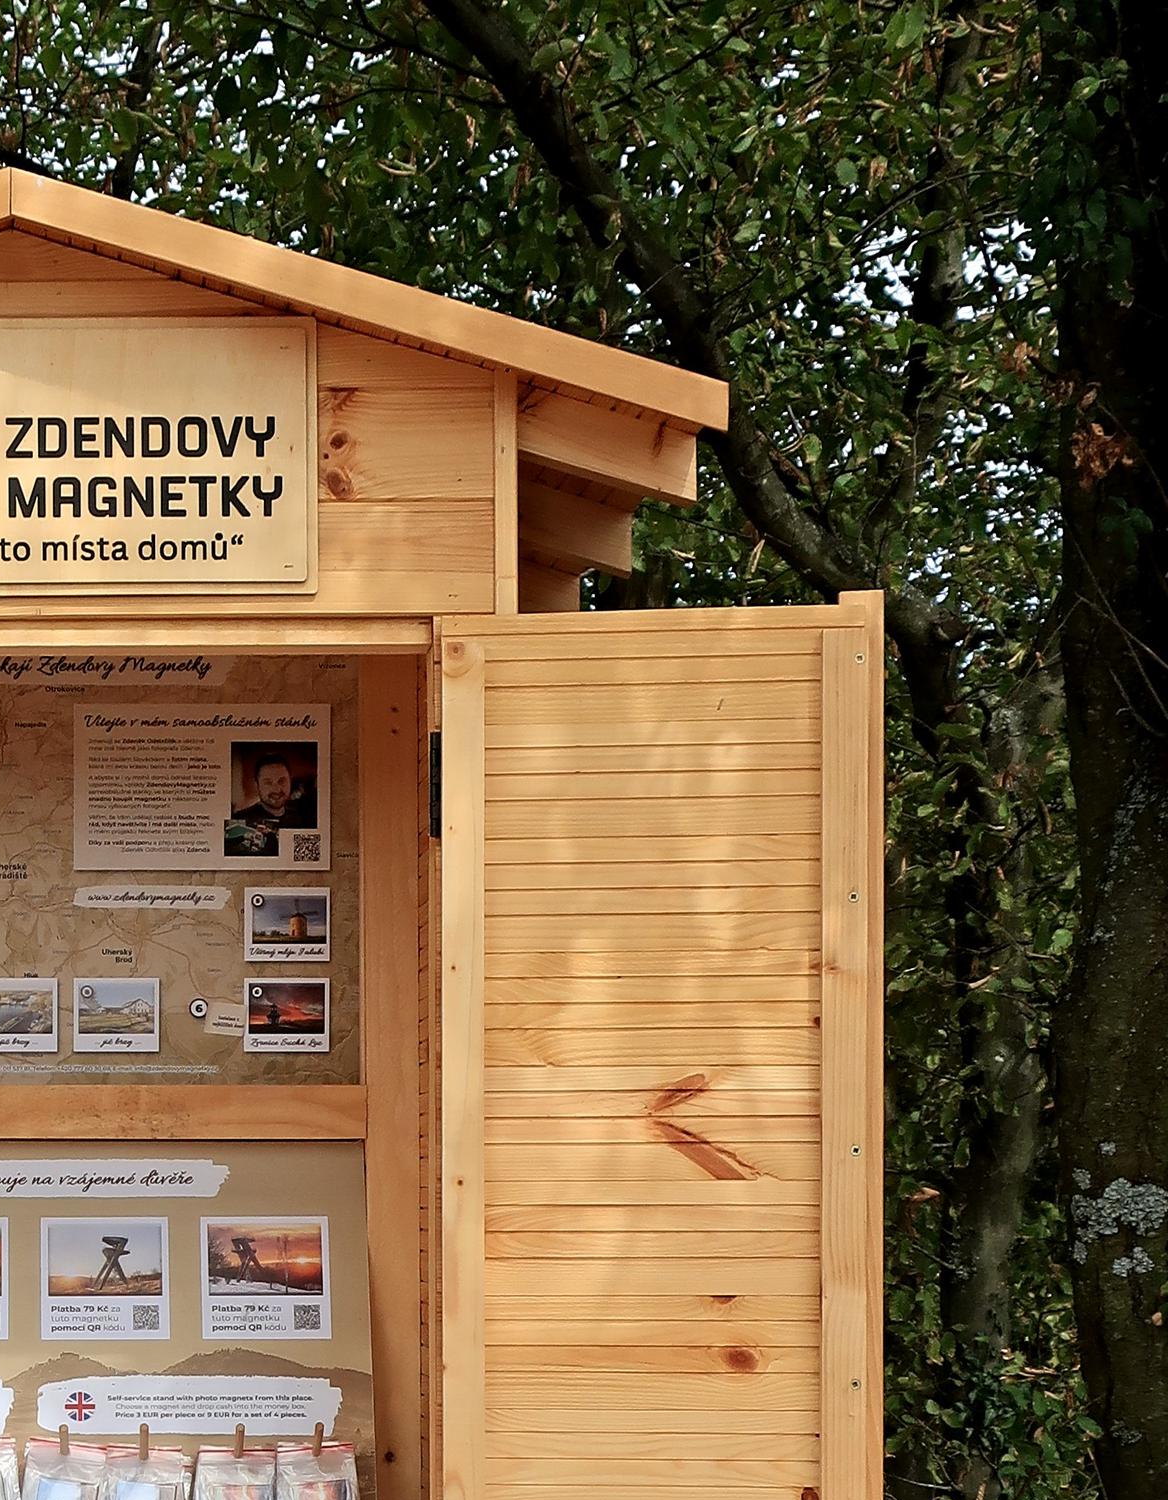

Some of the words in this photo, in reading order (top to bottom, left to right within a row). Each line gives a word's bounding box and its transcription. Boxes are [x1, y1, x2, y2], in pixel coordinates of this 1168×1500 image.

[5, 416, 277, 459] ZDENDOVY
[8, 475, 284, 518] MAGNETKY
[42, 535, 129, 562] místa
[37, 656, 115, 680] Zdendovy
[119, 656, 212, 680] Magnetky
[84, 714, 127, 732] Vítejte
[130, 718, 139, 727] v
[141, 717, 170, 727] mém
[172, 714, 271, 728] samoobslužném
[275, 715, 317, 729] stánku
[195, 1004, 203, 1013] 6
[32, 1176, 54, 1186] na
[59, 1171, 135, 1192] vzájemné
[140, 1169, 194, 1186] důvěře
[97, 1305, 109, 1313] Kč
[258, 1304, 270, 1312] Kč
[72, 1315, 119, 1323] magnetku
[233, 1314, 280, 1322] magnetku
[212, 1324, 246, 1332] pomocí
[197, 1403, 214, 1411] drop
[175, 1411, 196, 1419] piece
